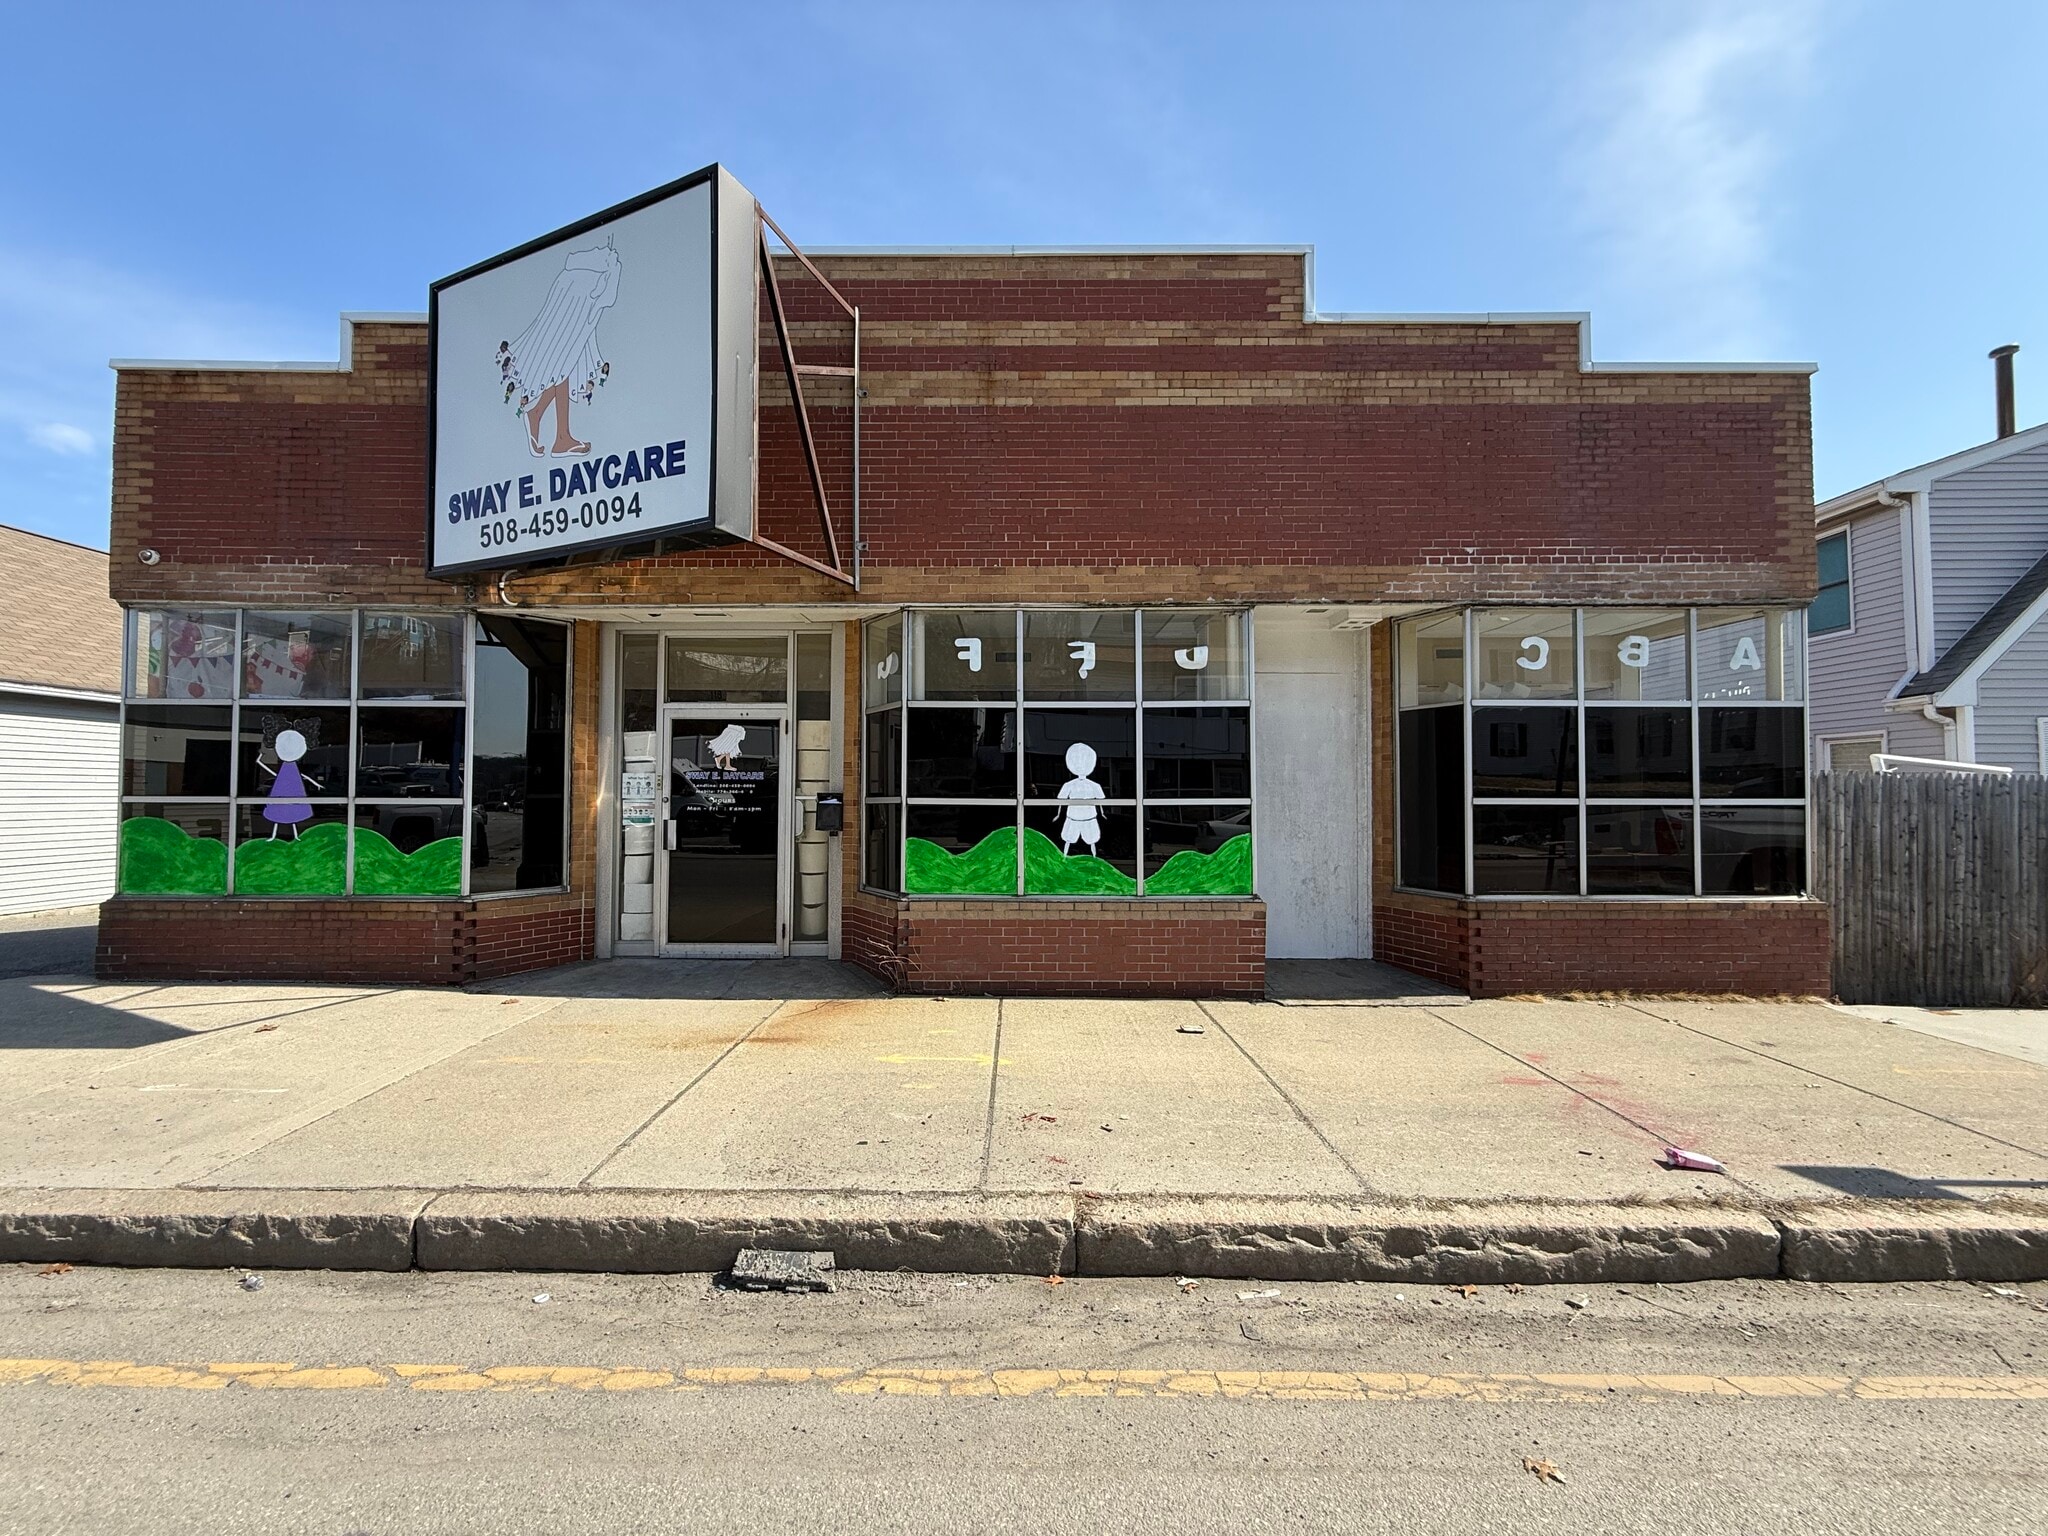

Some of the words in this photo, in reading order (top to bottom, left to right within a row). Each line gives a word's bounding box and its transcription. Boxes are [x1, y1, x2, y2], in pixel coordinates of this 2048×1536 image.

[448, 480, 511, 524] SWAY
[518, 474, 542, 509] E.
[549, 440, 686, 501] DAYCARE
[480, 491, 642, 548] 508-459-0094
[723, 772, 764, 780] DAYCARE
